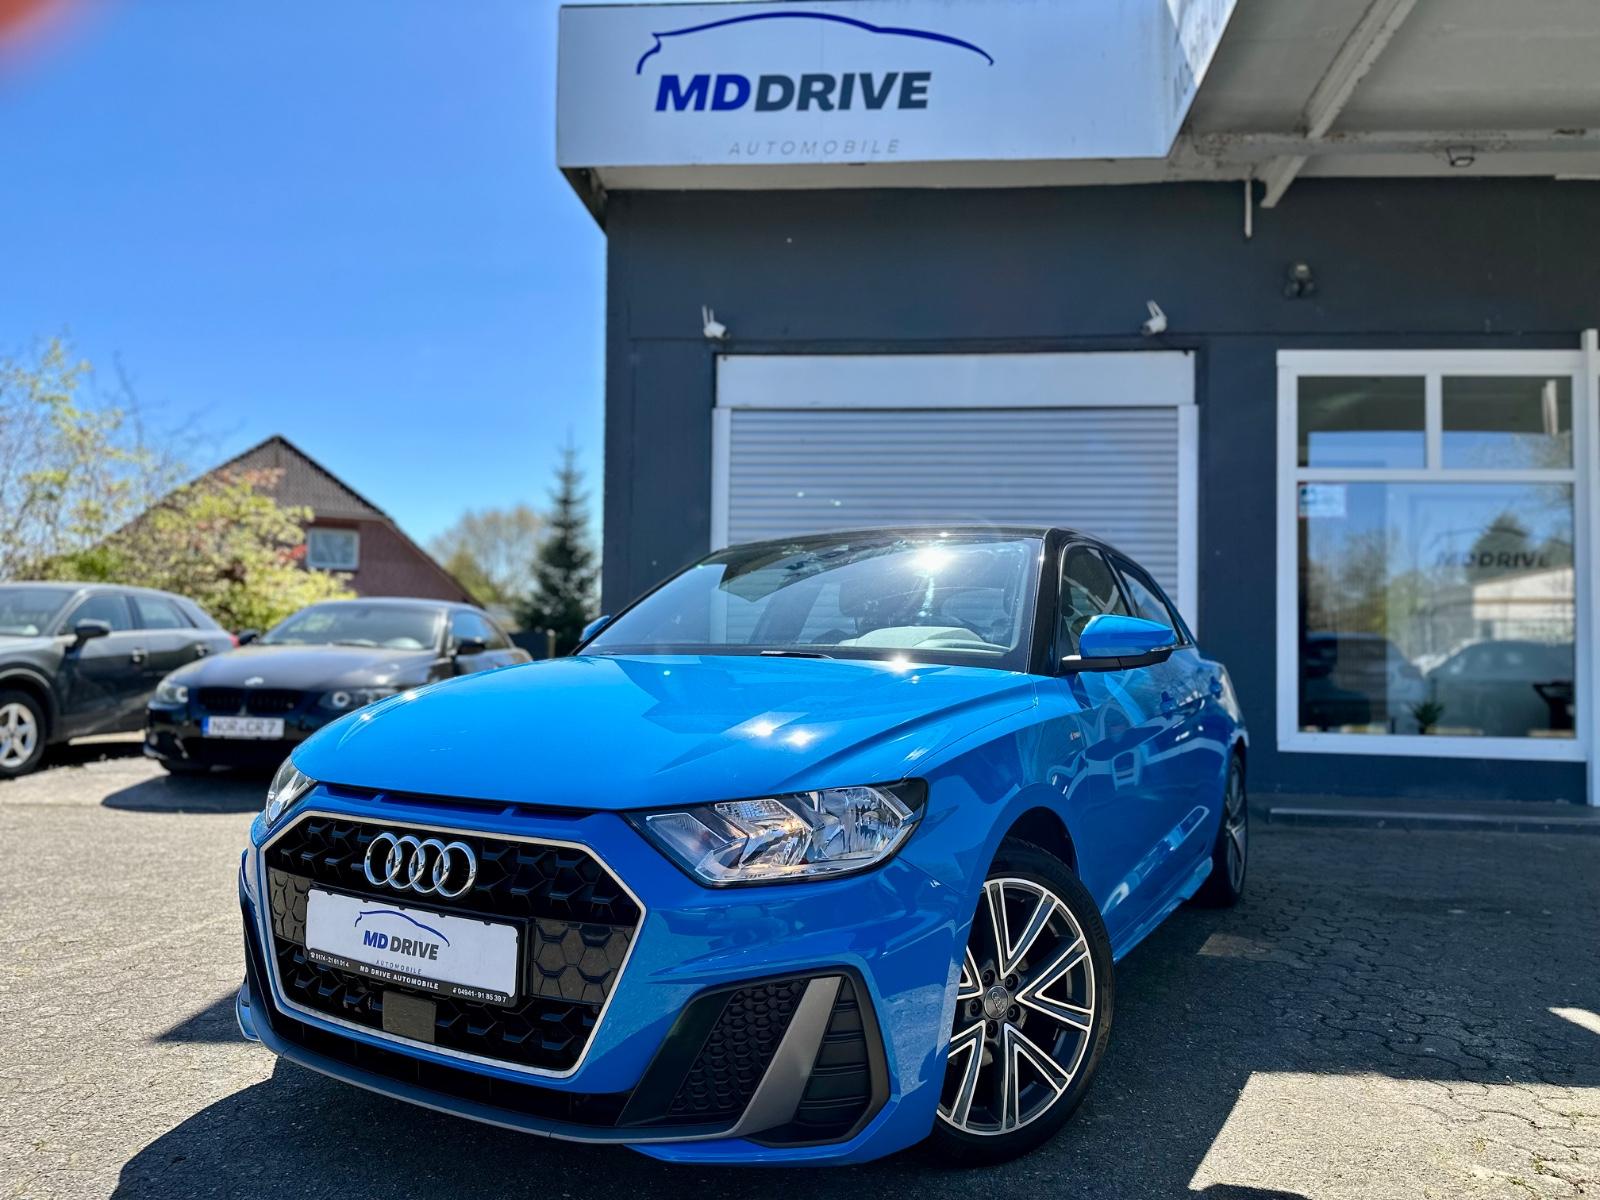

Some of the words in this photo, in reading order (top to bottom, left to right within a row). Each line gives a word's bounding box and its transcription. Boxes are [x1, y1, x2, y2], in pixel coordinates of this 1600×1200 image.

[729, 139, 901, 157] AUTOMOBILE
[376, 959, 422, 975] AUTOMOBILE
[359, 965, 370, 973] MD
[371, 968, 391, 979] DRIVE
[393, 974, 439, 990] AUTOMOBILE
